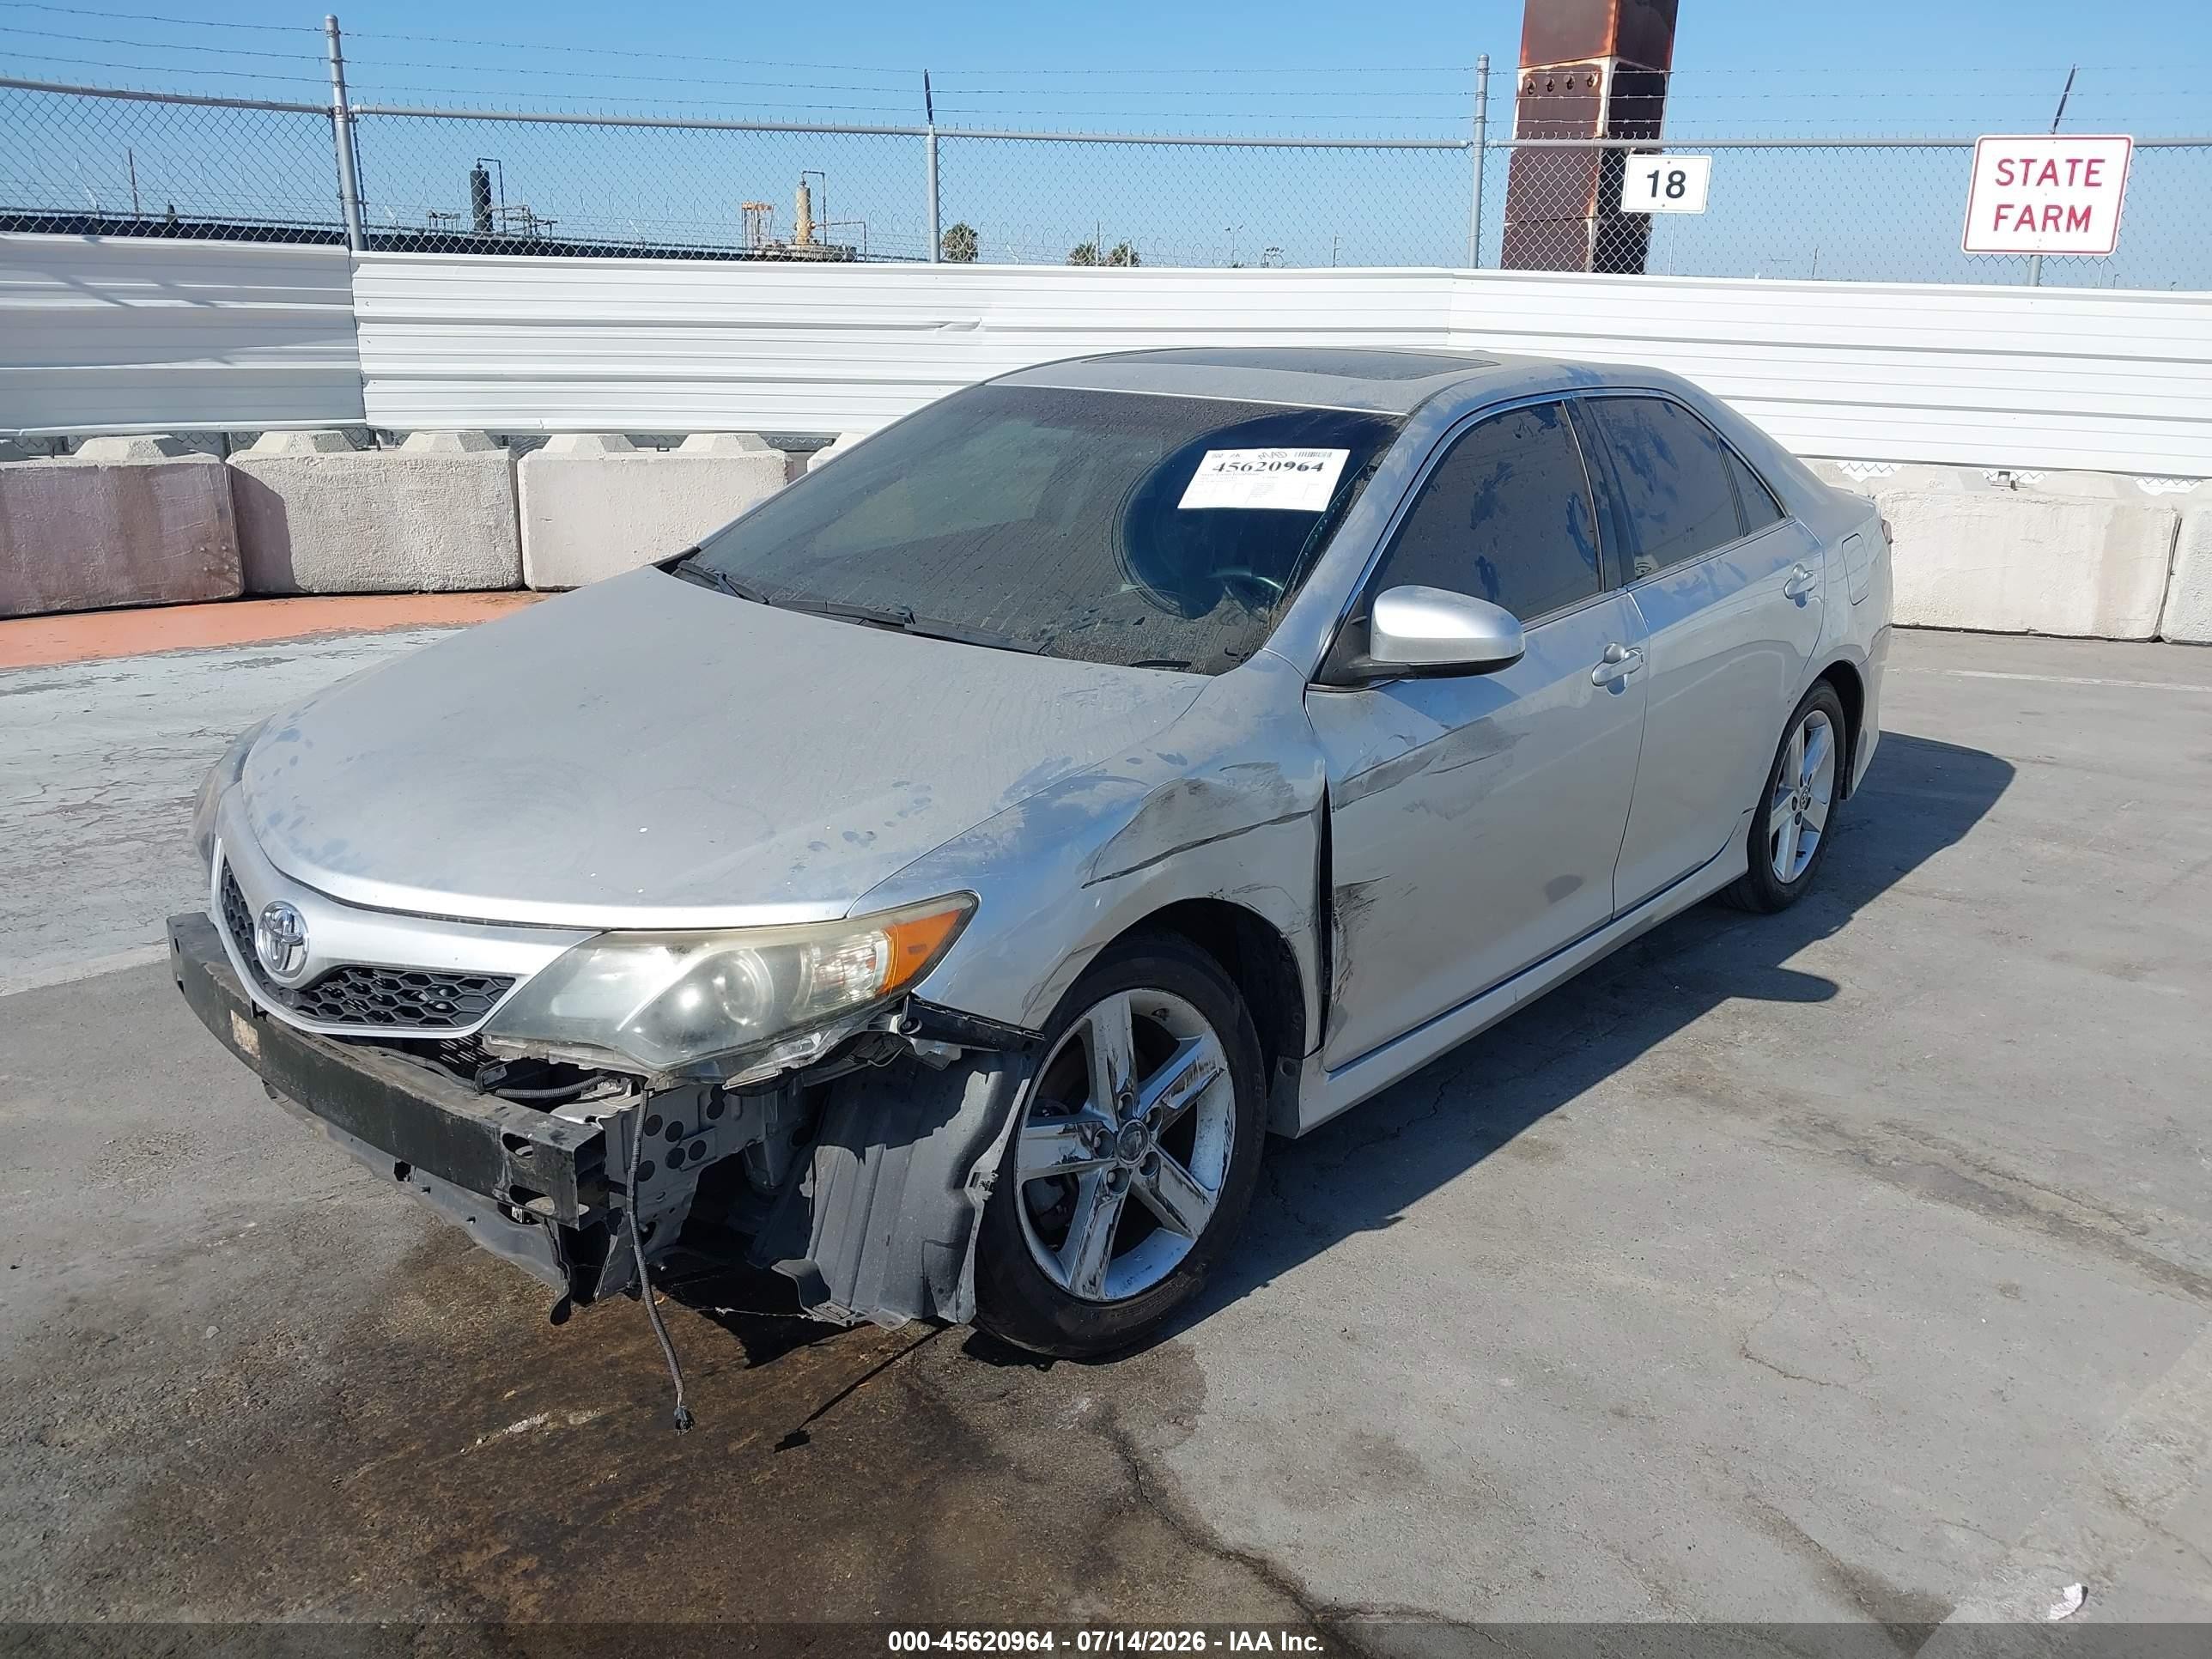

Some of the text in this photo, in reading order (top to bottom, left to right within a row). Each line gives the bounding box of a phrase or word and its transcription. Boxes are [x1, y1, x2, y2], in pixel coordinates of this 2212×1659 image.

[1646, 170, 1686, 199] 18
[1995, 158, 2106, 187] STATE
[1993, 204, 2093, 233] FARM
[1212, 461, 1325, 472] 45620964
